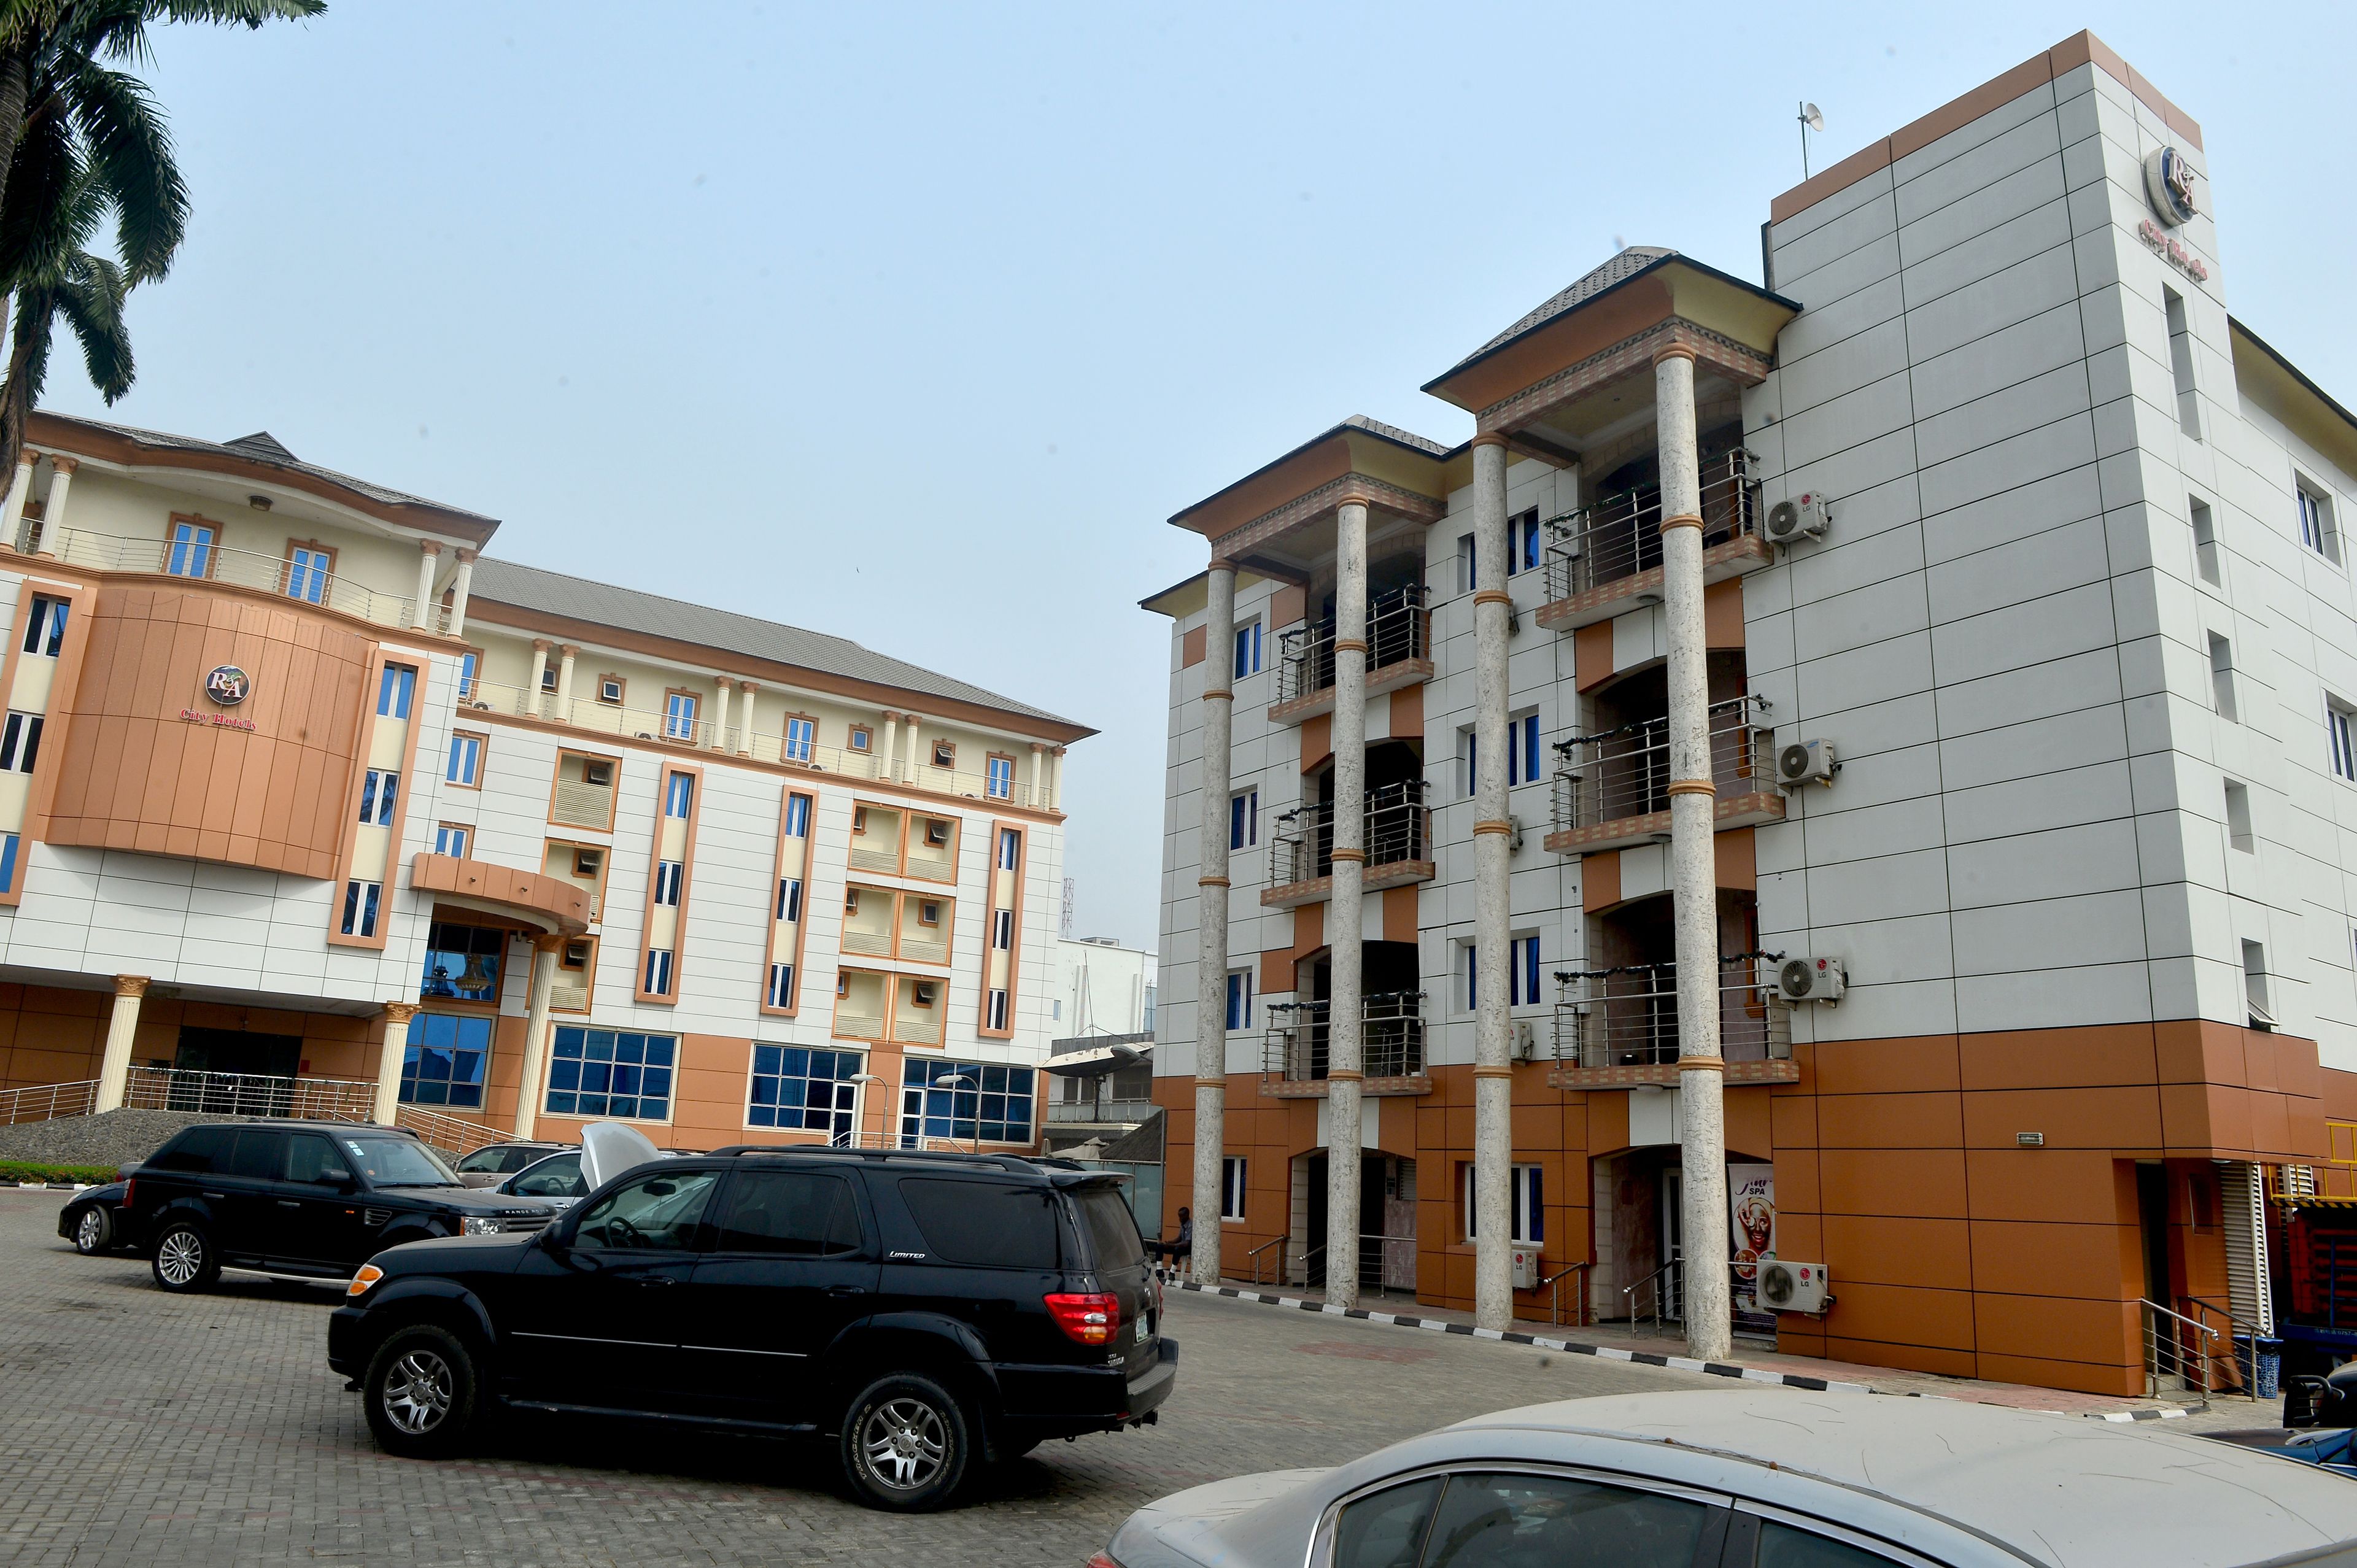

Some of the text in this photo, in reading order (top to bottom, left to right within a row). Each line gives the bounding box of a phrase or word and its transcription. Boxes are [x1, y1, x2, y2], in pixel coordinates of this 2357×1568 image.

[208, 671, 243, 698] R&A
[180, 708, 258, 731] City Hotels
[852, 1415, 867, 1480] TRACKER
